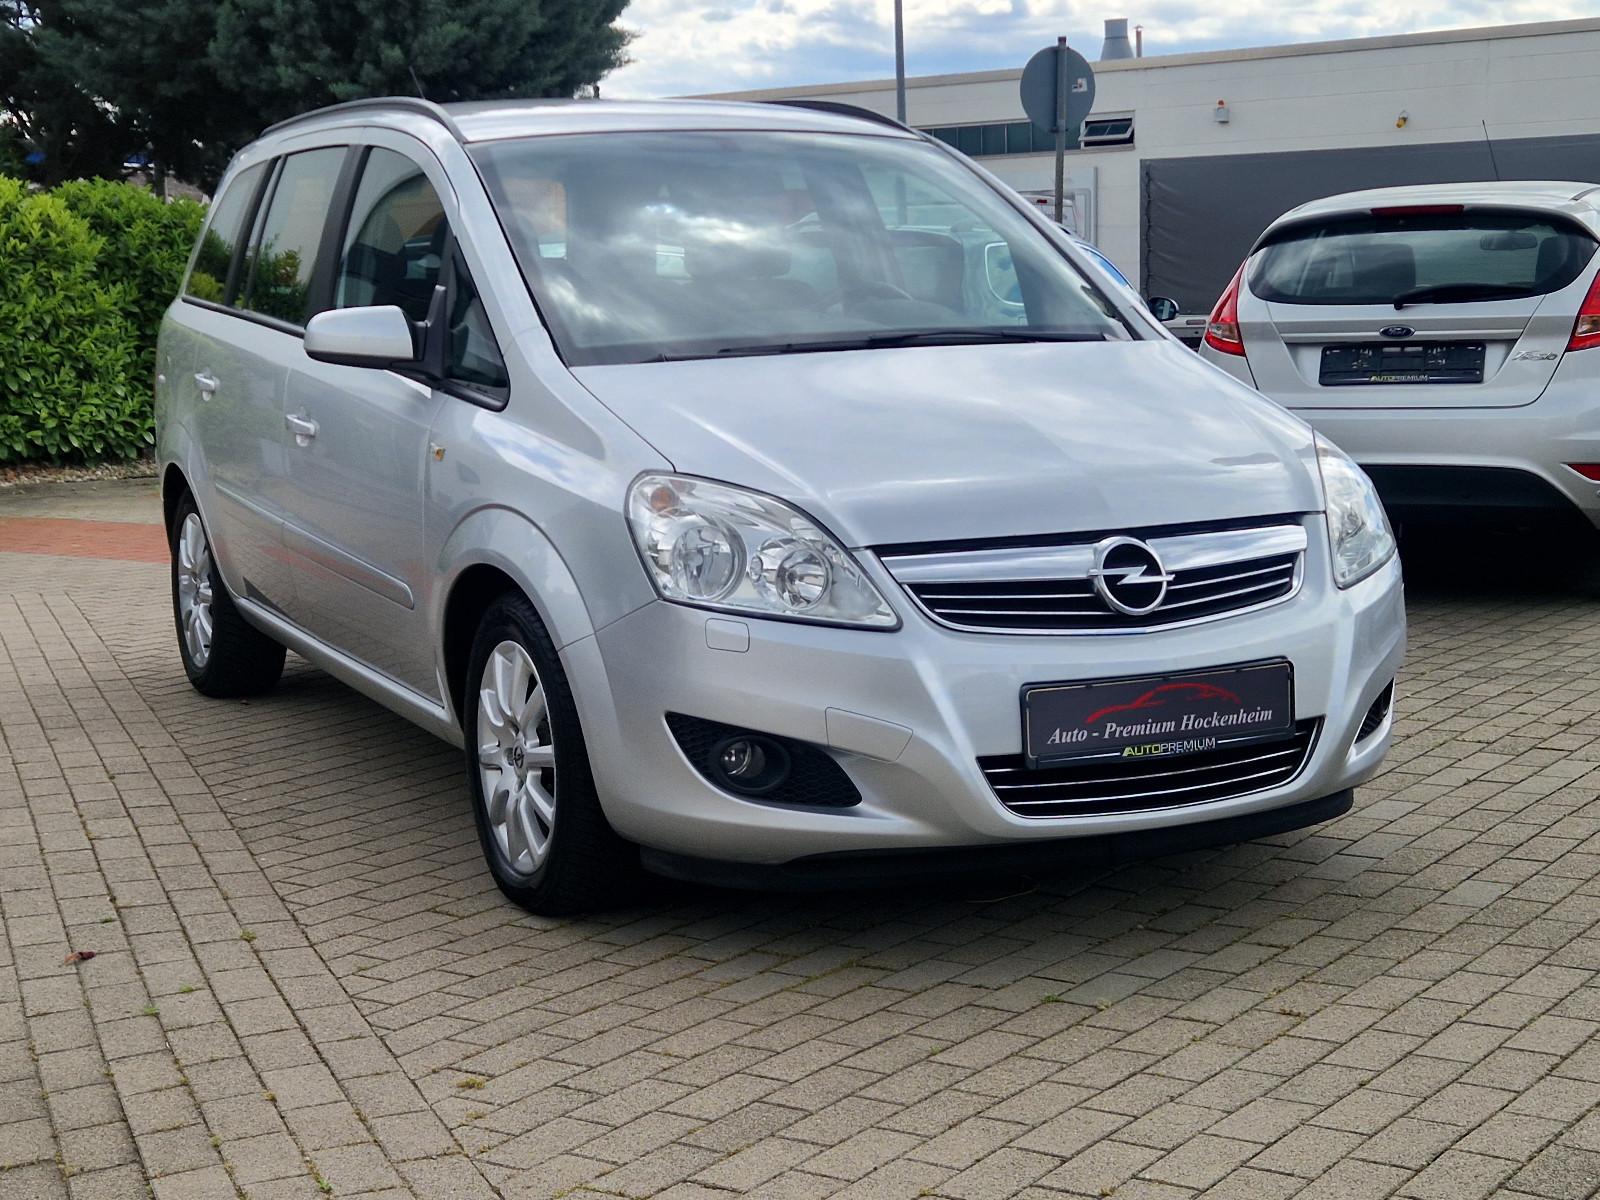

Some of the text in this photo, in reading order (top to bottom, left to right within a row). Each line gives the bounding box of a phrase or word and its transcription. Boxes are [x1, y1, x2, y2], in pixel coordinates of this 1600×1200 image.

[1047, 727, 1088, 745] Auto
[1104, 718, 1176, 740] Premium
[1180, 707, 1273, 731] Hockenheim
[1122, 737, 1216, 757] AUTOPREMIUM
